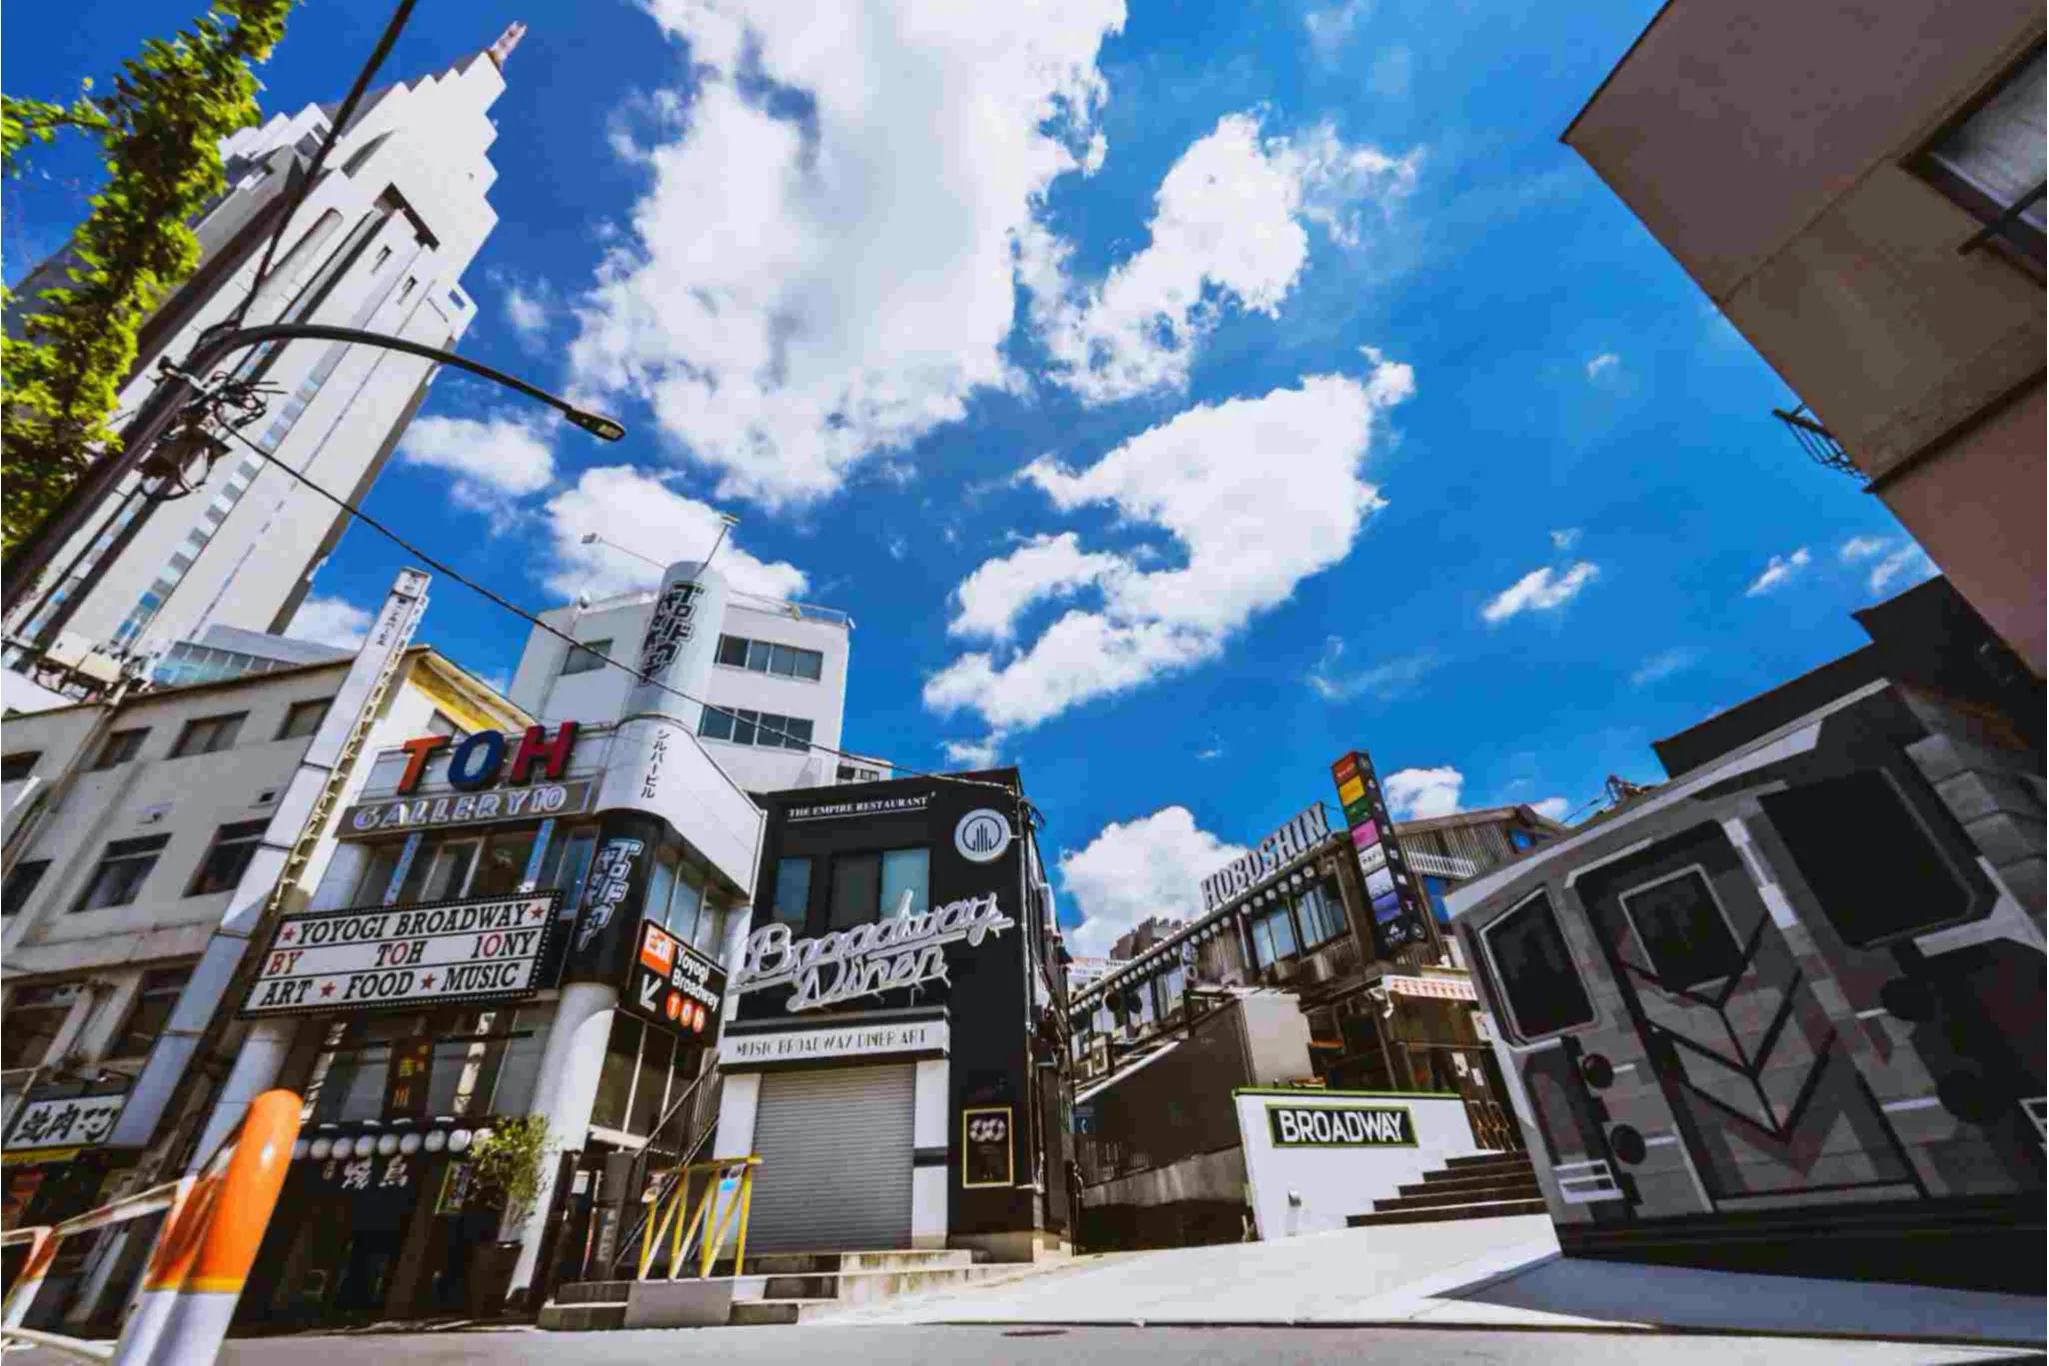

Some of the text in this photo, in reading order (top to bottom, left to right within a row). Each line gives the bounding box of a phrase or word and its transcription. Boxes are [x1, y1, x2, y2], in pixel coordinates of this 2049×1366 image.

[397, 718, 580, 796] TOH
[788, 796, 929, 818] THE EMPIRE RESTAURANT
[297, 902, 532, 945] YOYOGI BROADWAY
[725, 889, 1015, 990] Broadway
[265, 950, 304, 976] BY
[374, 940, 428, 967] TOH
[677, 946, 711, 985] Yoyogi
[787, 944, 950, 1012] Diner
[259, 962, 521, 1006] ART FOOD MUSIC
[671, 966, 720, 1012] Broadway
[736, 1041, 770, 1057] MUSIC
[778, 1035, 853, 1053] BROADWAY
[1277, 1109, 1403, 1143] BROADWAY
